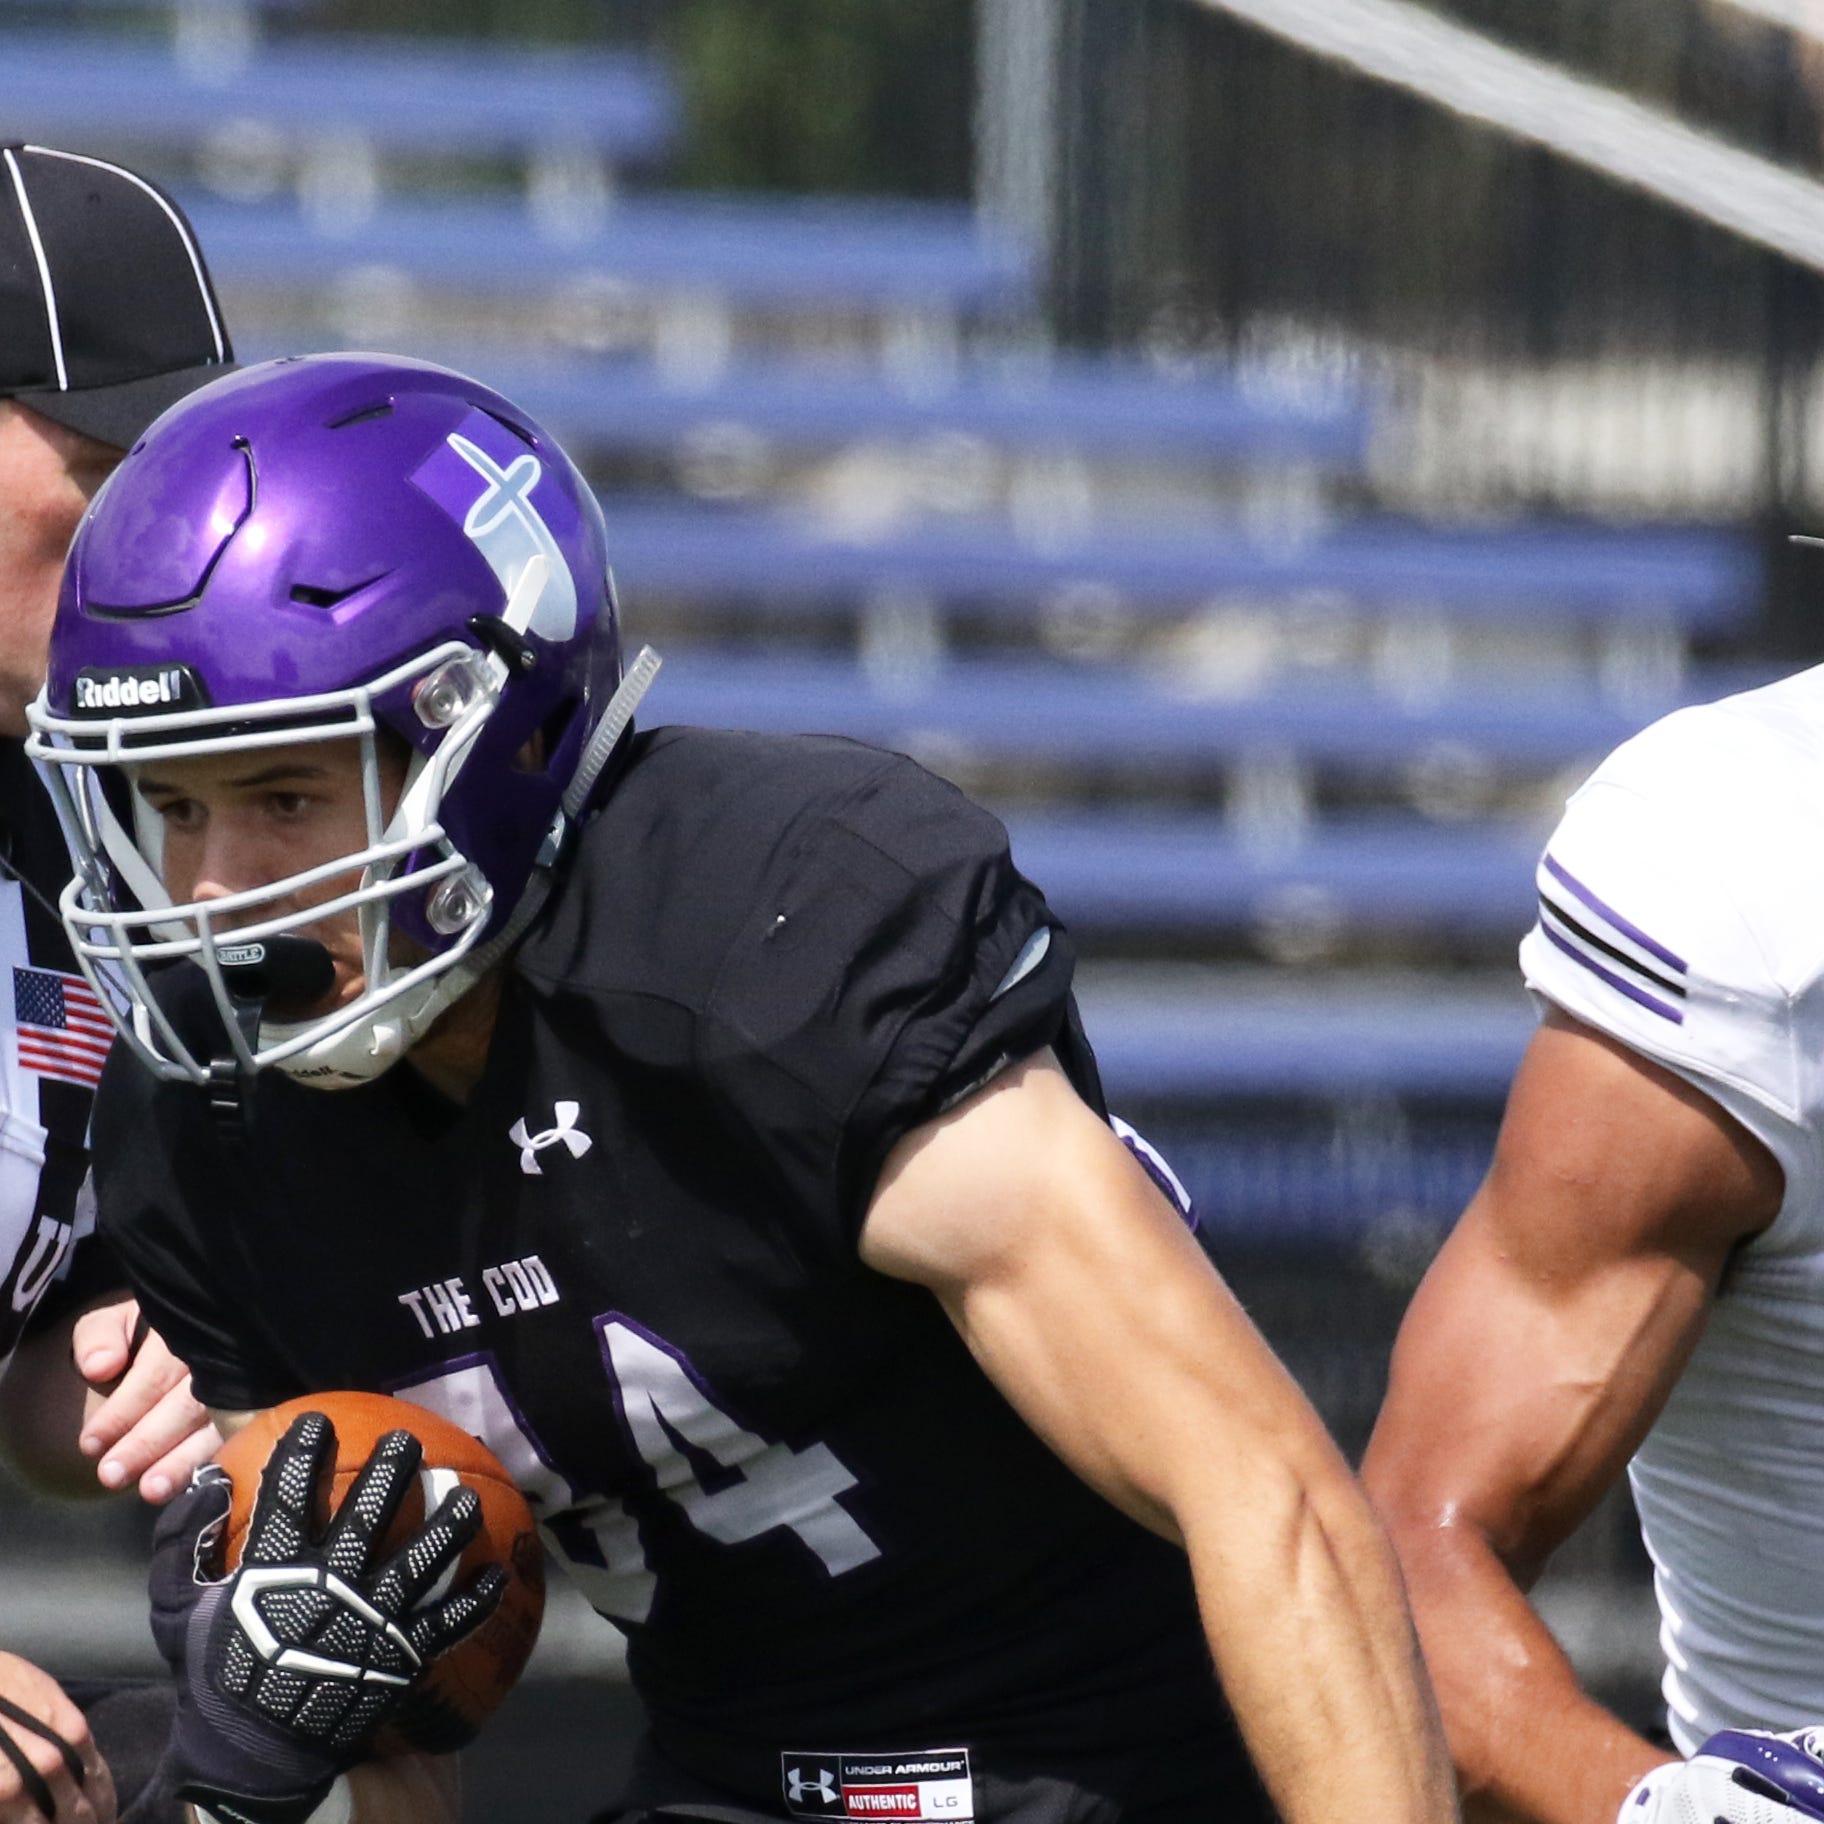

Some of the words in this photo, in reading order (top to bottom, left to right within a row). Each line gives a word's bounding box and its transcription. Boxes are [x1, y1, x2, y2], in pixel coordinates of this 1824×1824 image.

[76, 669, 181, 708] Riddell
[398, 1276, 480, 1339] THE
[845, 1764, 892, 1776] UNDER
[894, 1760, 962, 1776] ARMOUR
[848, 1793, 917, 1811] AUTHENTIC
